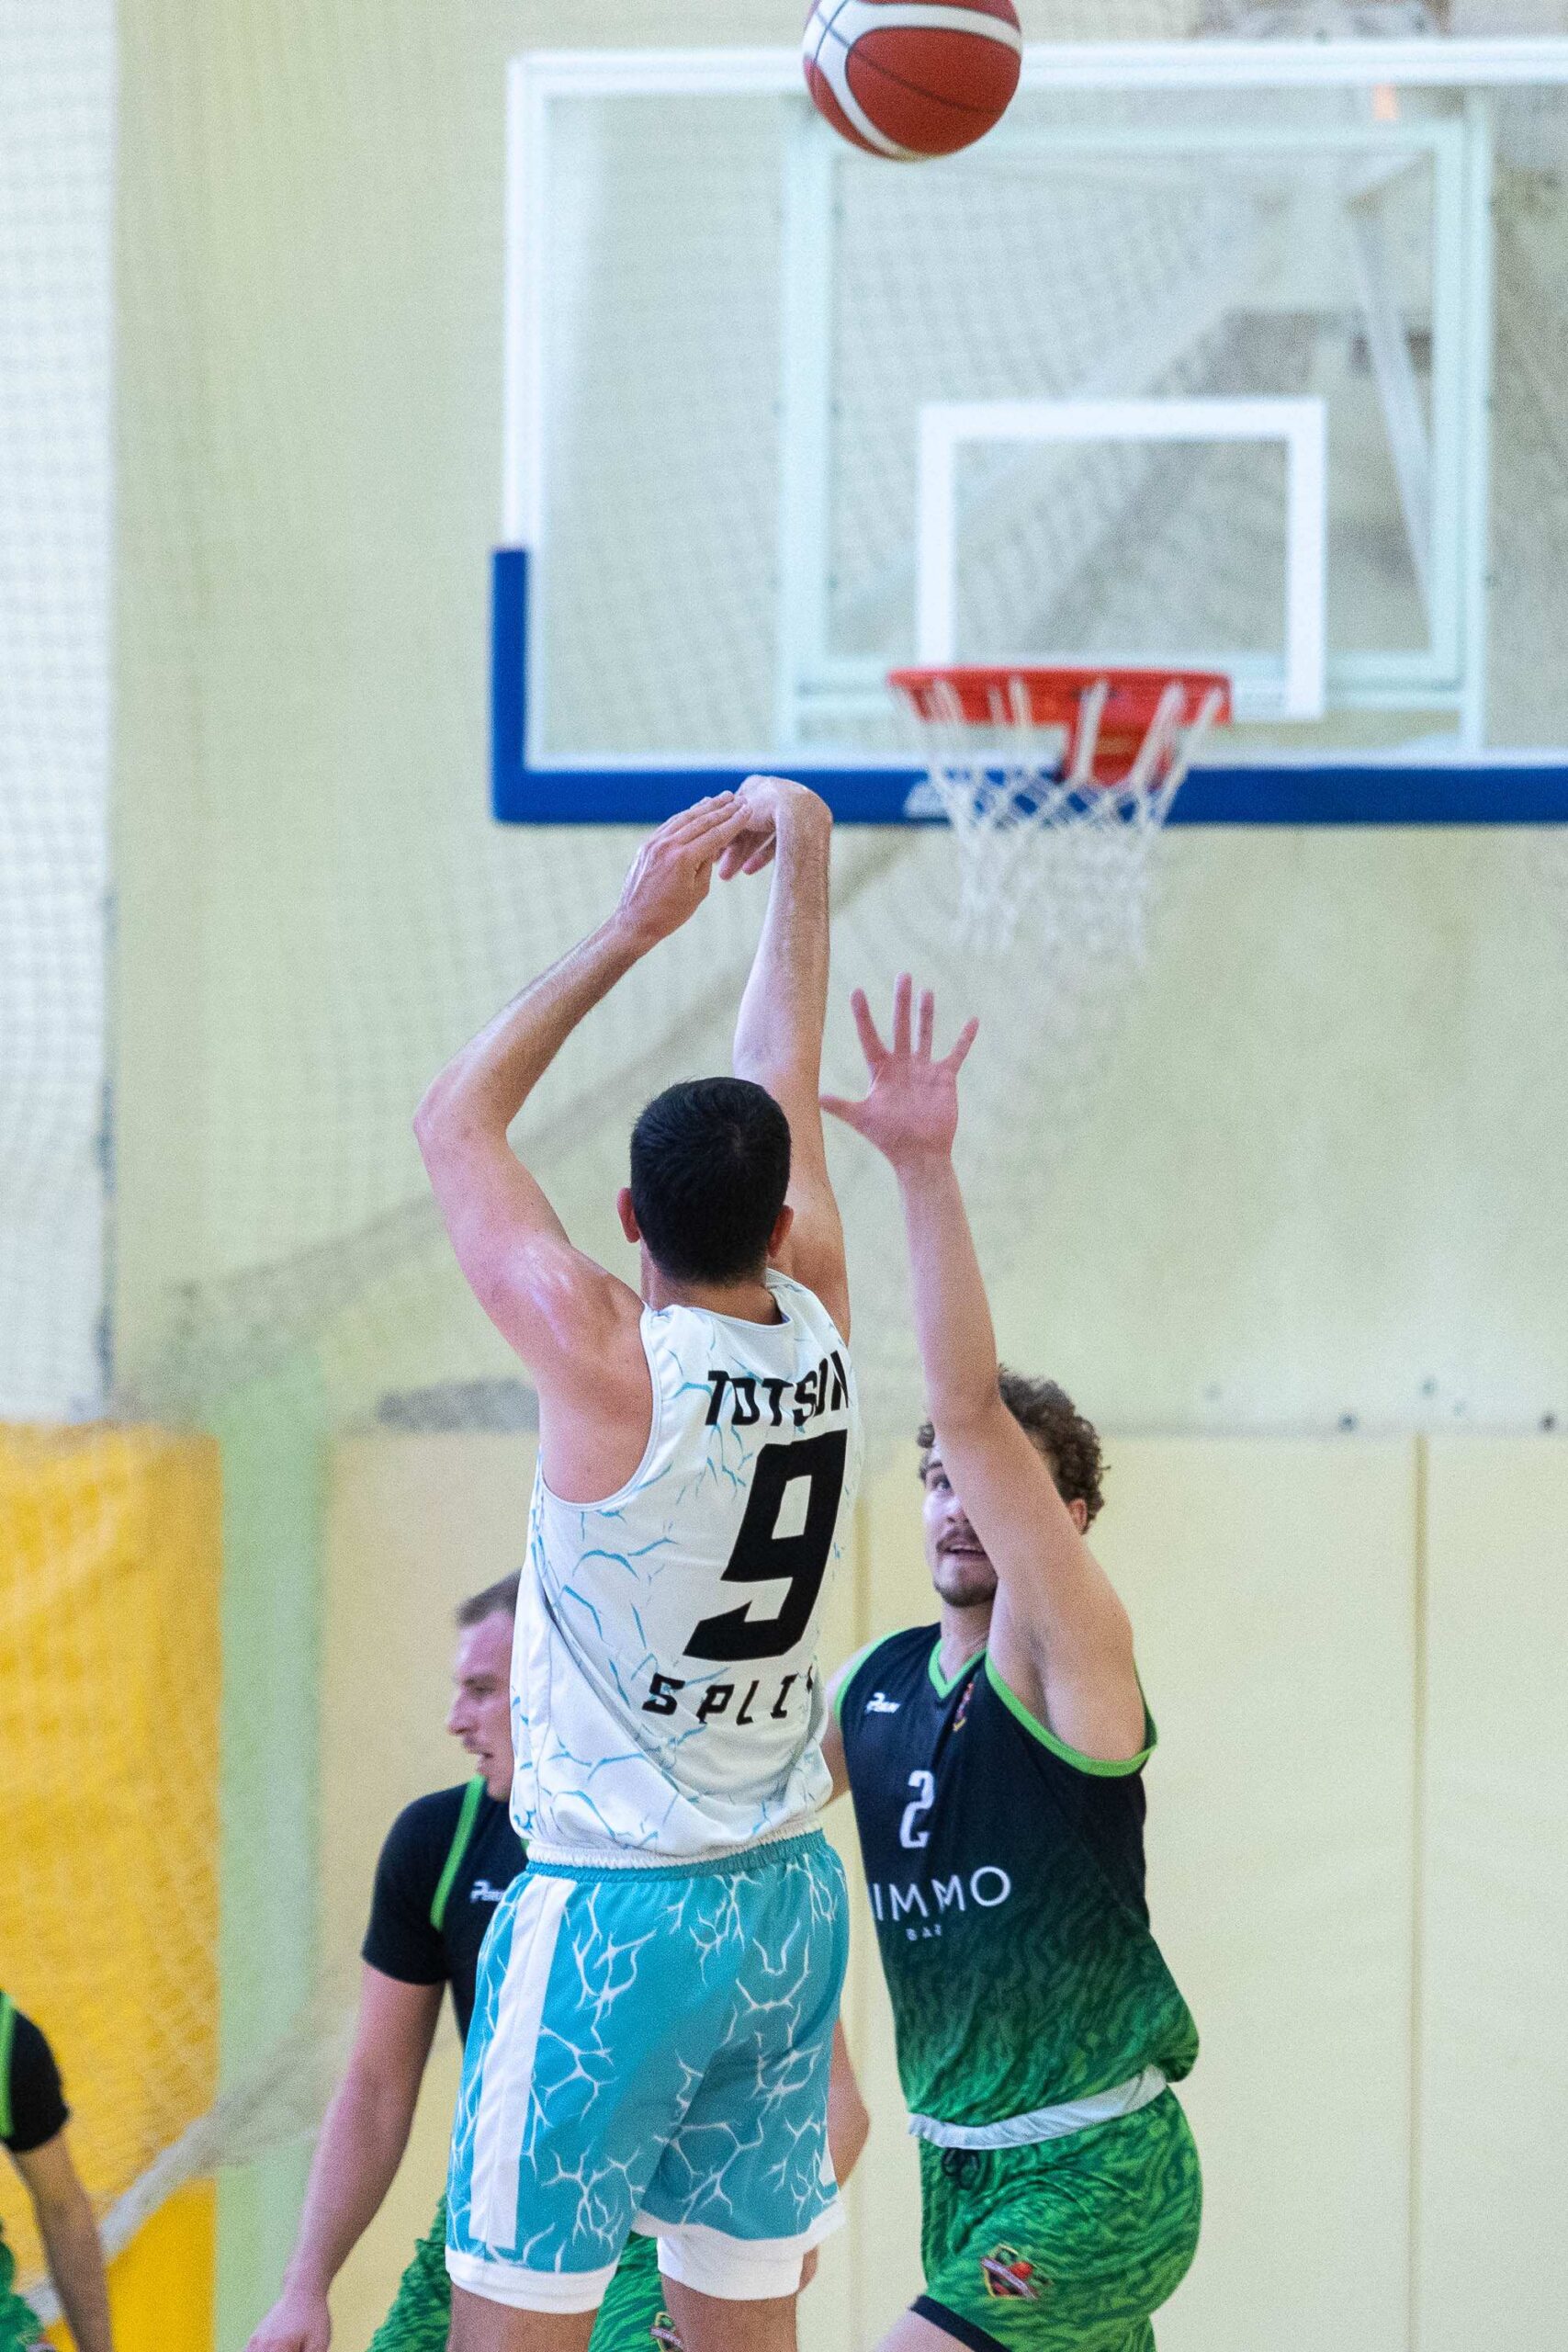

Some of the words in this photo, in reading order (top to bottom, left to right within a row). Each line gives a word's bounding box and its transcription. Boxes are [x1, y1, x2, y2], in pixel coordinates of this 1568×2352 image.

[682, 1429, 847, 1662] 9
[898, 1770, 935, 1849] 2
[873, 1865, 1011, 1922] IMMO
